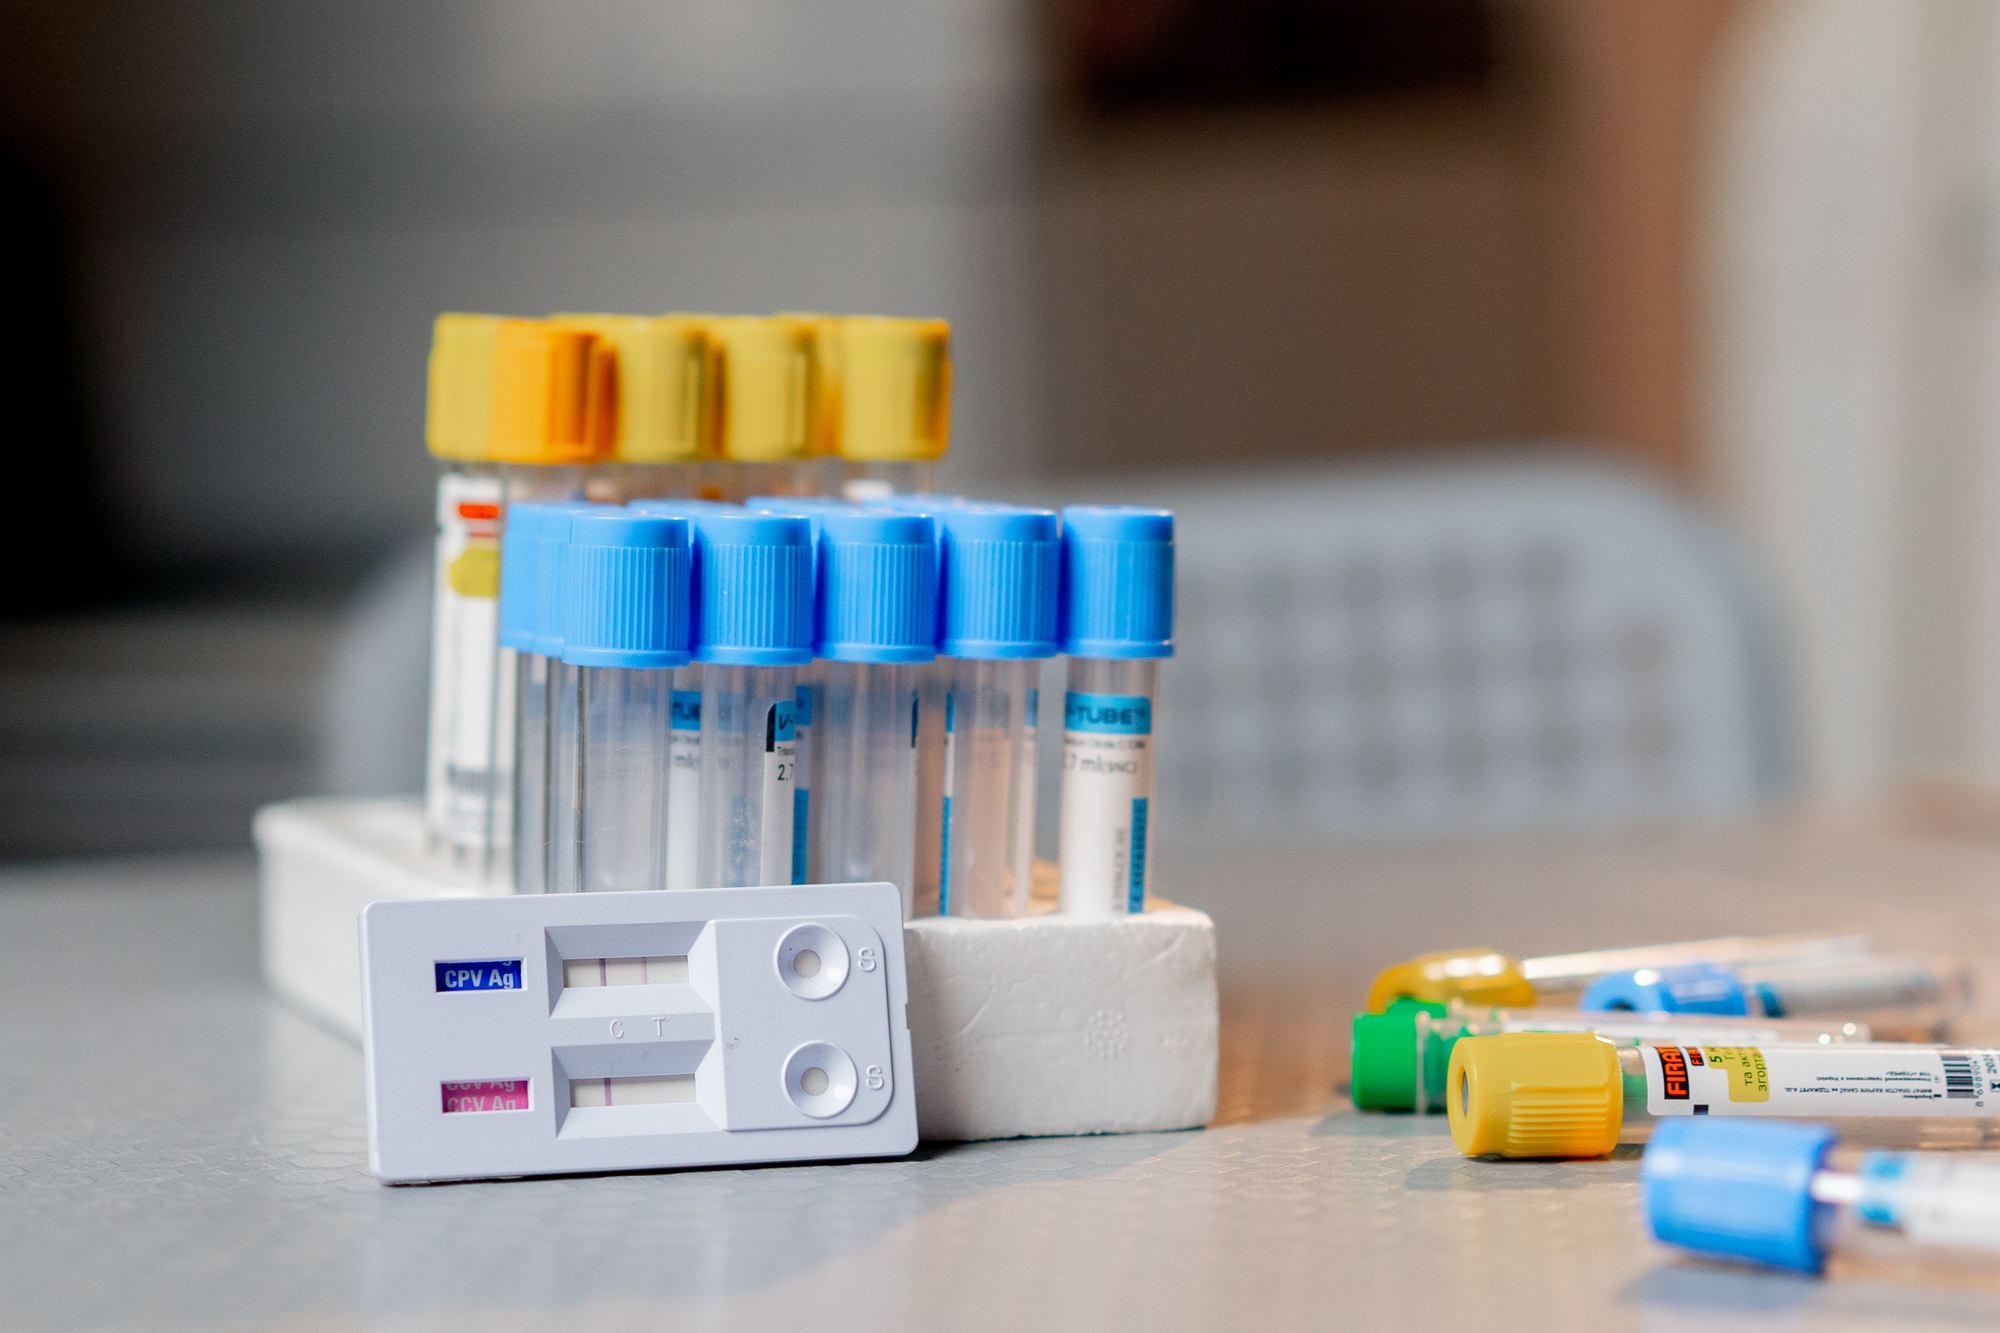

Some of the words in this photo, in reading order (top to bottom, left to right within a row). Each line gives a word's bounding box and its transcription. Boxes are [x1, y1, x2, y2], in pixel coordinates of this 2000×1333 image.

[858, 946, 877, 973] S
[444, 969, 483, 988] CPV
[488, 968, 514, 989] Ag
[609, 1018, 625, 1040] C
[651, 1016, 666, 1037] T
[1709, 1055, 1723, 1063] 5
[865, 1064, 885, 1090] S
[446, 1096, 485, 1113] CCV
